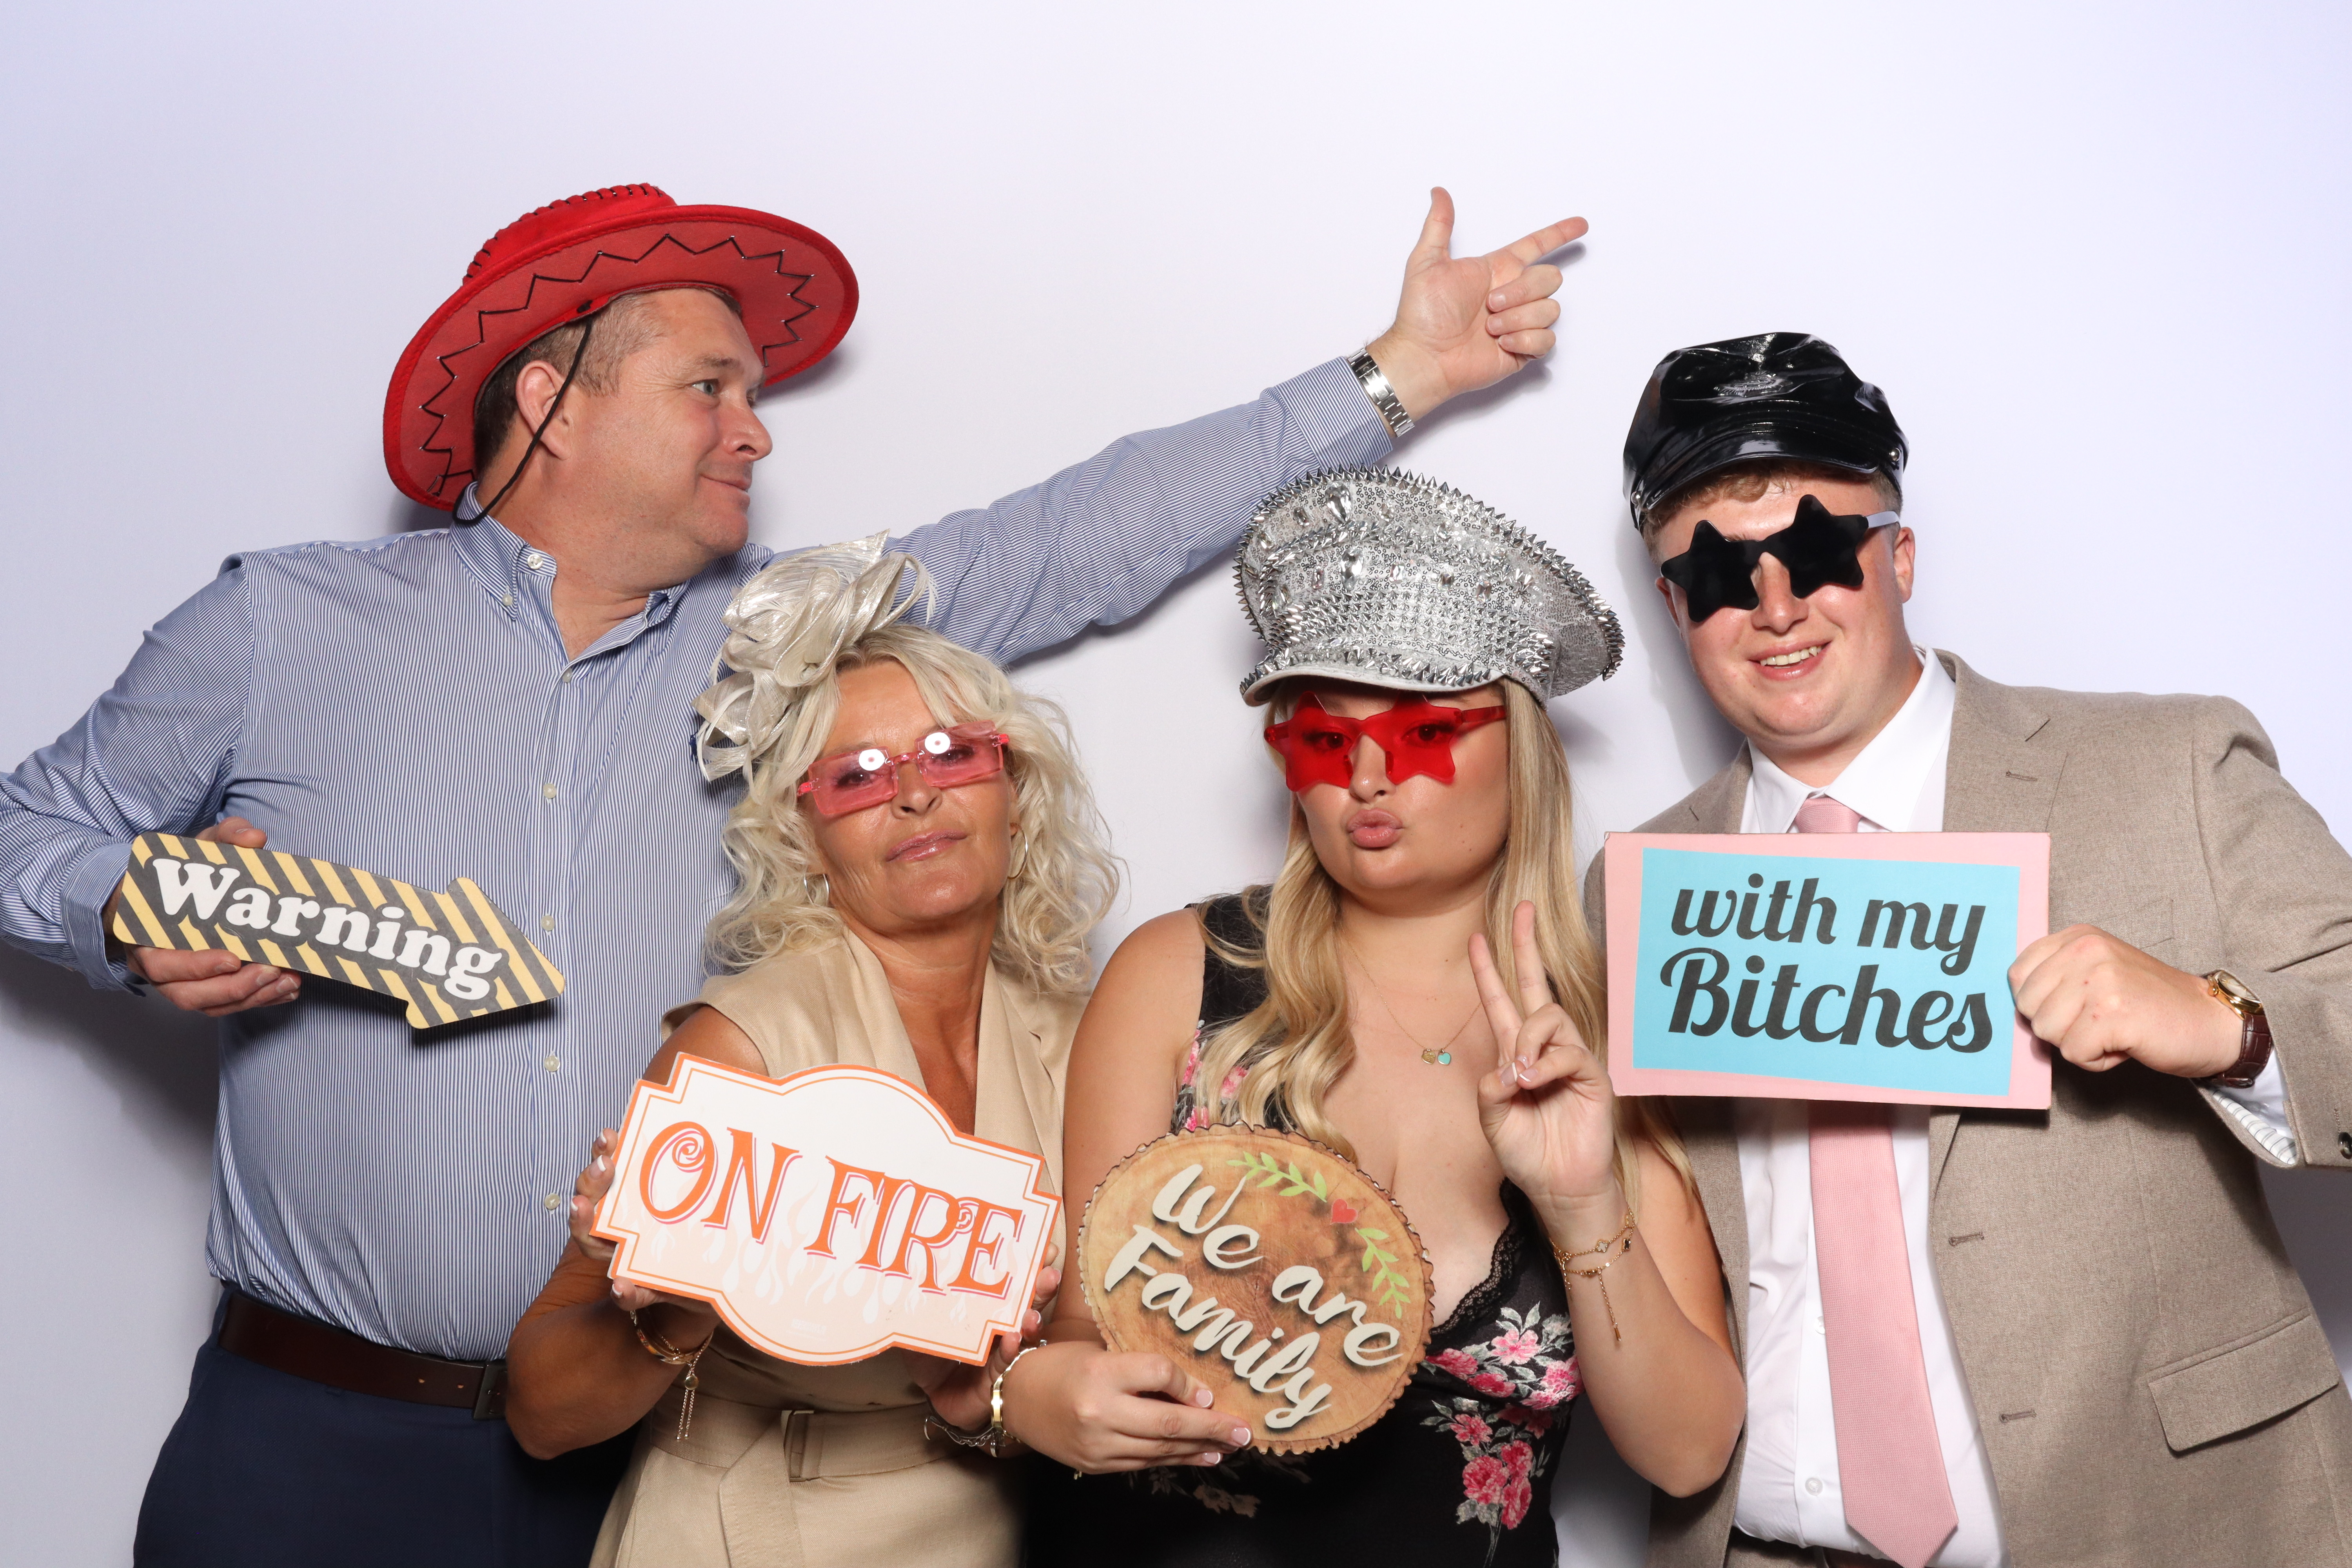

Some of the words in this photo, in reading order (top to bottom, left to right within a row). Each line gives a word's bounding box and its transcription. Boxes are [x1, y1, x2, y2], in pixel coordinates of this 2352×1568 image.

[152, 858, 502, 1000] Warning
[1660, 947, 1993, 1053] Bitches
[1670, 873, 1837, 944] with
[1857, 898, 1986, 976] my
[639, 1120, 802, 1244] ON
[804, 1154, 1025, 1300] FIRE
[1152, 1163, 1263, 1269] We
[1272, 1265, 1403, 1366] are
[1103, 1224, 1332, 1429] Family
